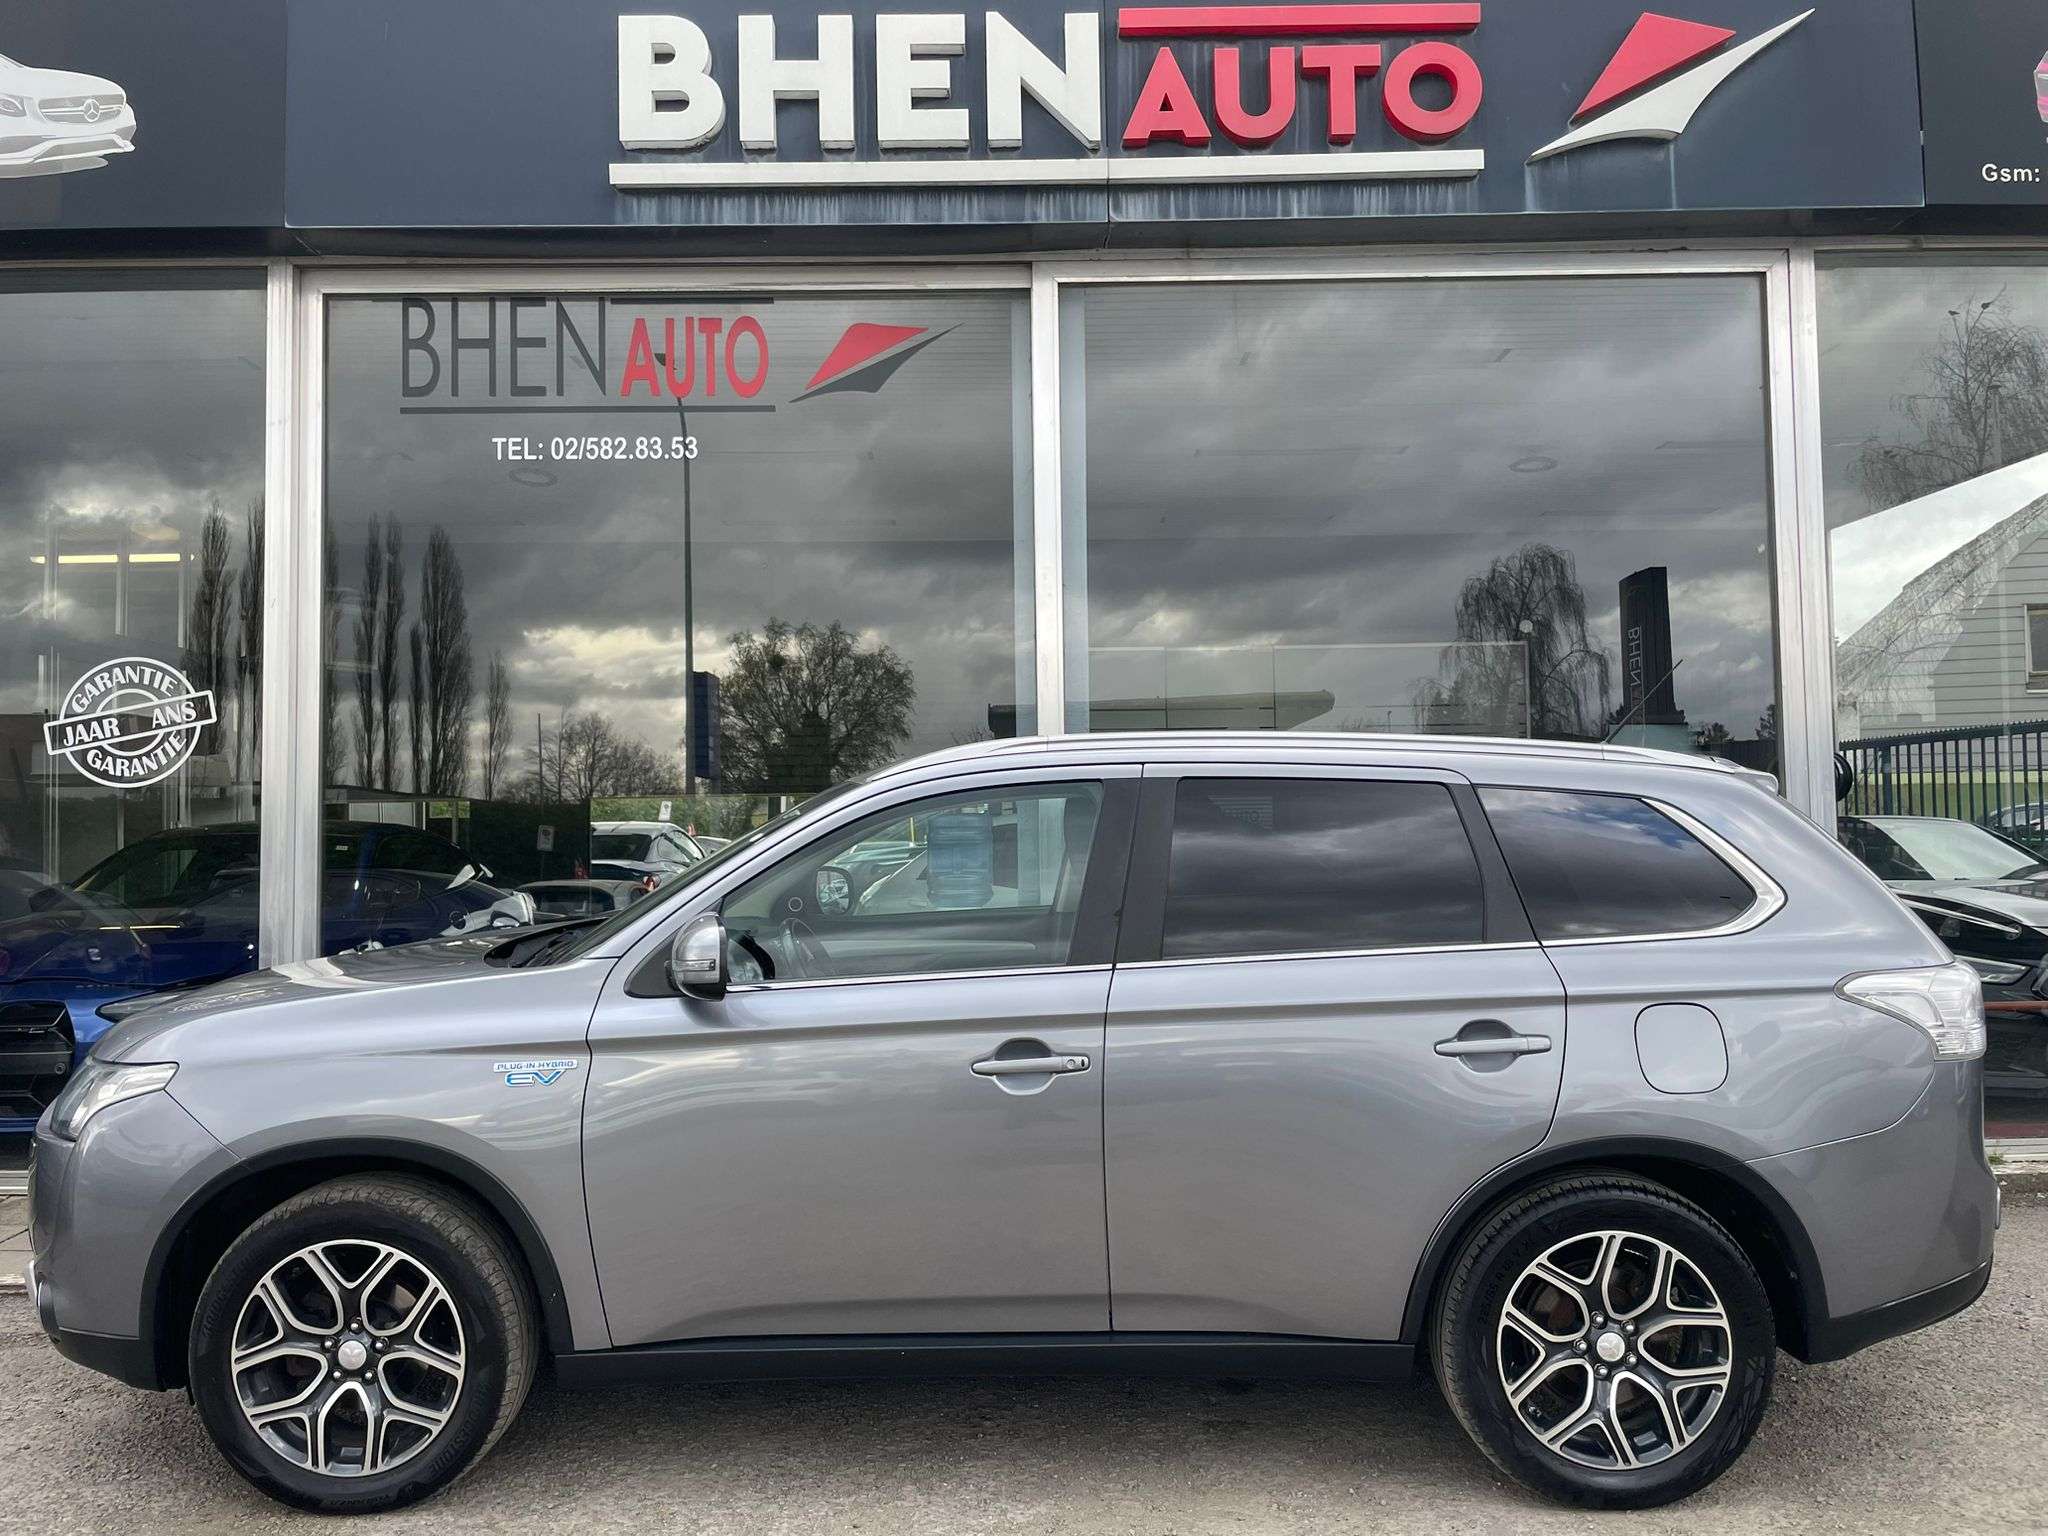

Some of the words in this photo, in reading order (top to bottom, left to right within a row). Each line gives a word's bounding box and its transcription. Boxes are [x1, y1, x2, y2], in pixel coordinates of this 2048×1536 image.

[616, 11, 1101, 151] BHEN
[1120, 40, 1483, 149] AUTO
[1981, 163, 2040, 182] Gsm:
[402, 297, 606, 398] BHEN
[619, 315, 770, 399] AUTO
[491, 436, 544, 462] TEL:
[550, 435, 699, 462] 02/582.83.53
[71, 665, 178, 714] GARANTIE
[63, 717, 121, 747] JAAR
[152, 700, 197, 729] ANS
[86, 729, 187, 777] GARANTIE
